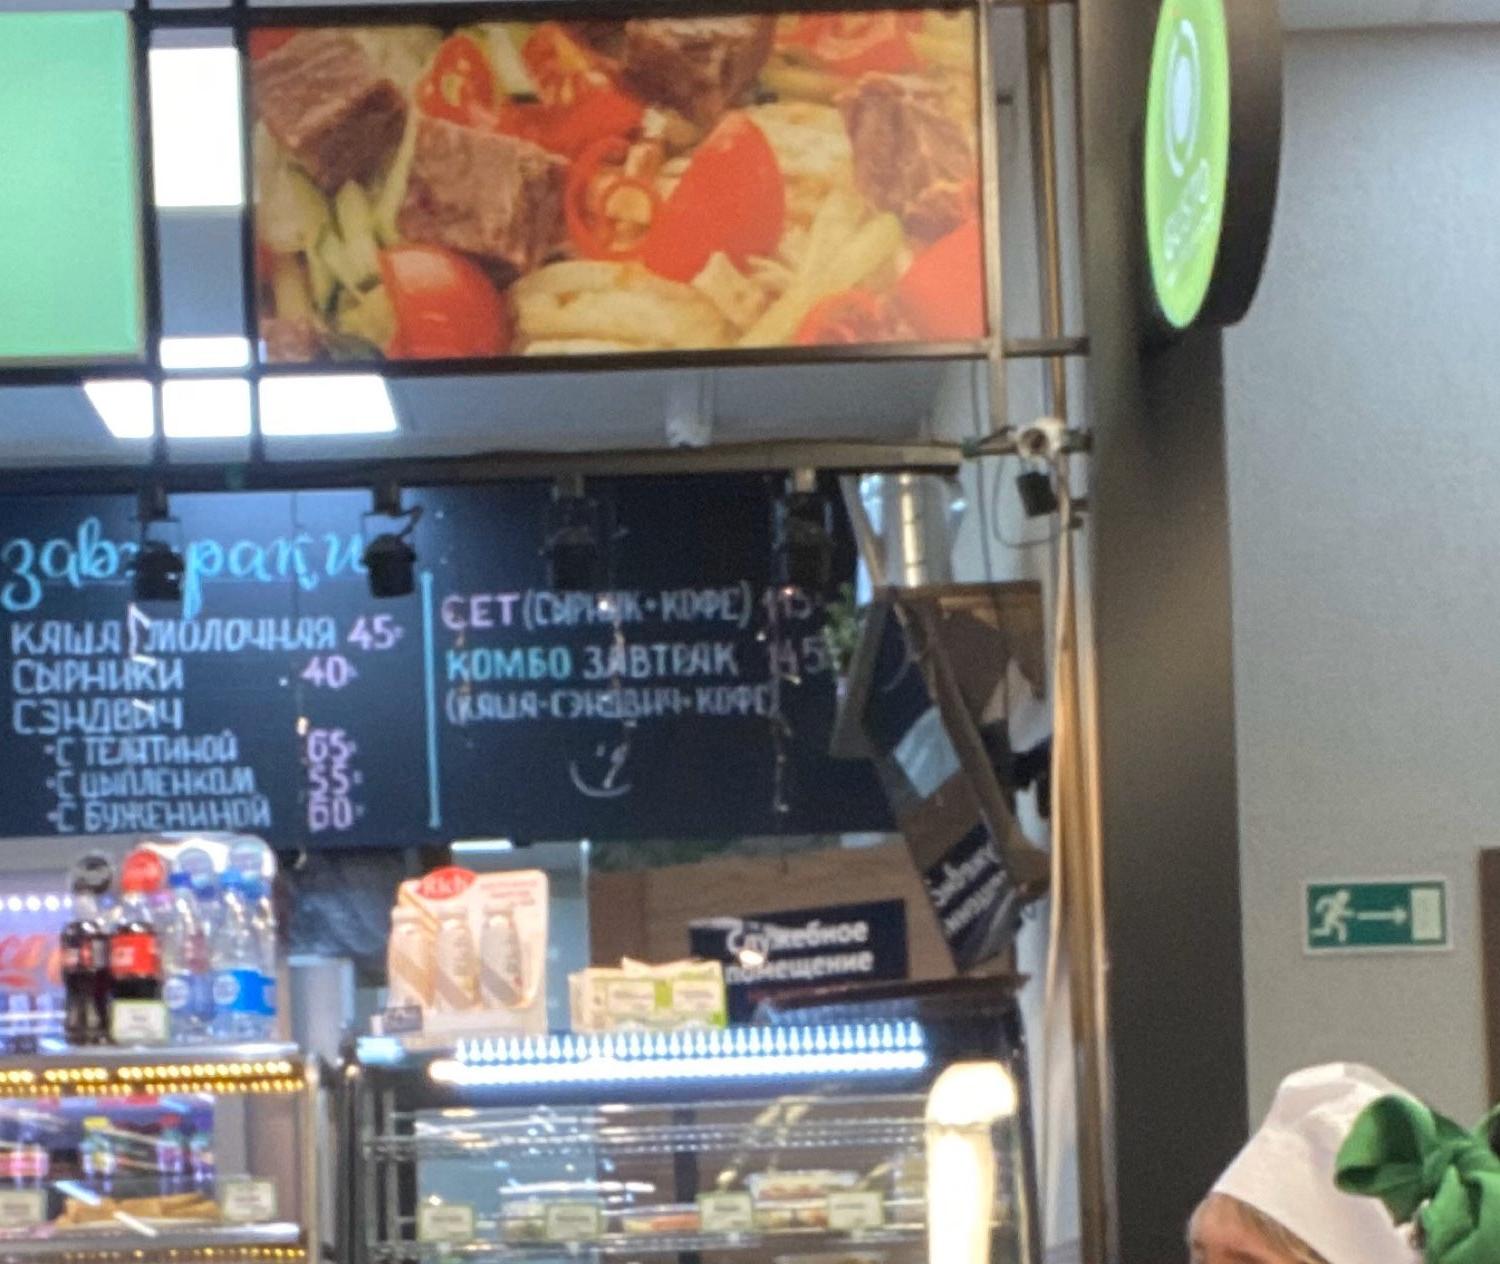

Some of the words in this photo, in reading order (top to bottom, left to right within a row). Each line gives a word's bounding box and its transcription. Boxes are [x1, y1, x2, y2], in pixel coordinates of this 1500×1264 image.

[0, 517, 368, 619] завраки
[441, 591, 520, 631] СЕТ
[11, 619, 122, 655] КАША
[144, 615, 336, 653] МОЛОЧНАЯ
[11, 657, 184, 694] СЫРНИКИ
[445, 645, 572, 681] КОМБО
[582, 641, 740, 680] ЗАВТРАК
[85, 728, 239, 767] ТЕЛЯТИНОЙ
